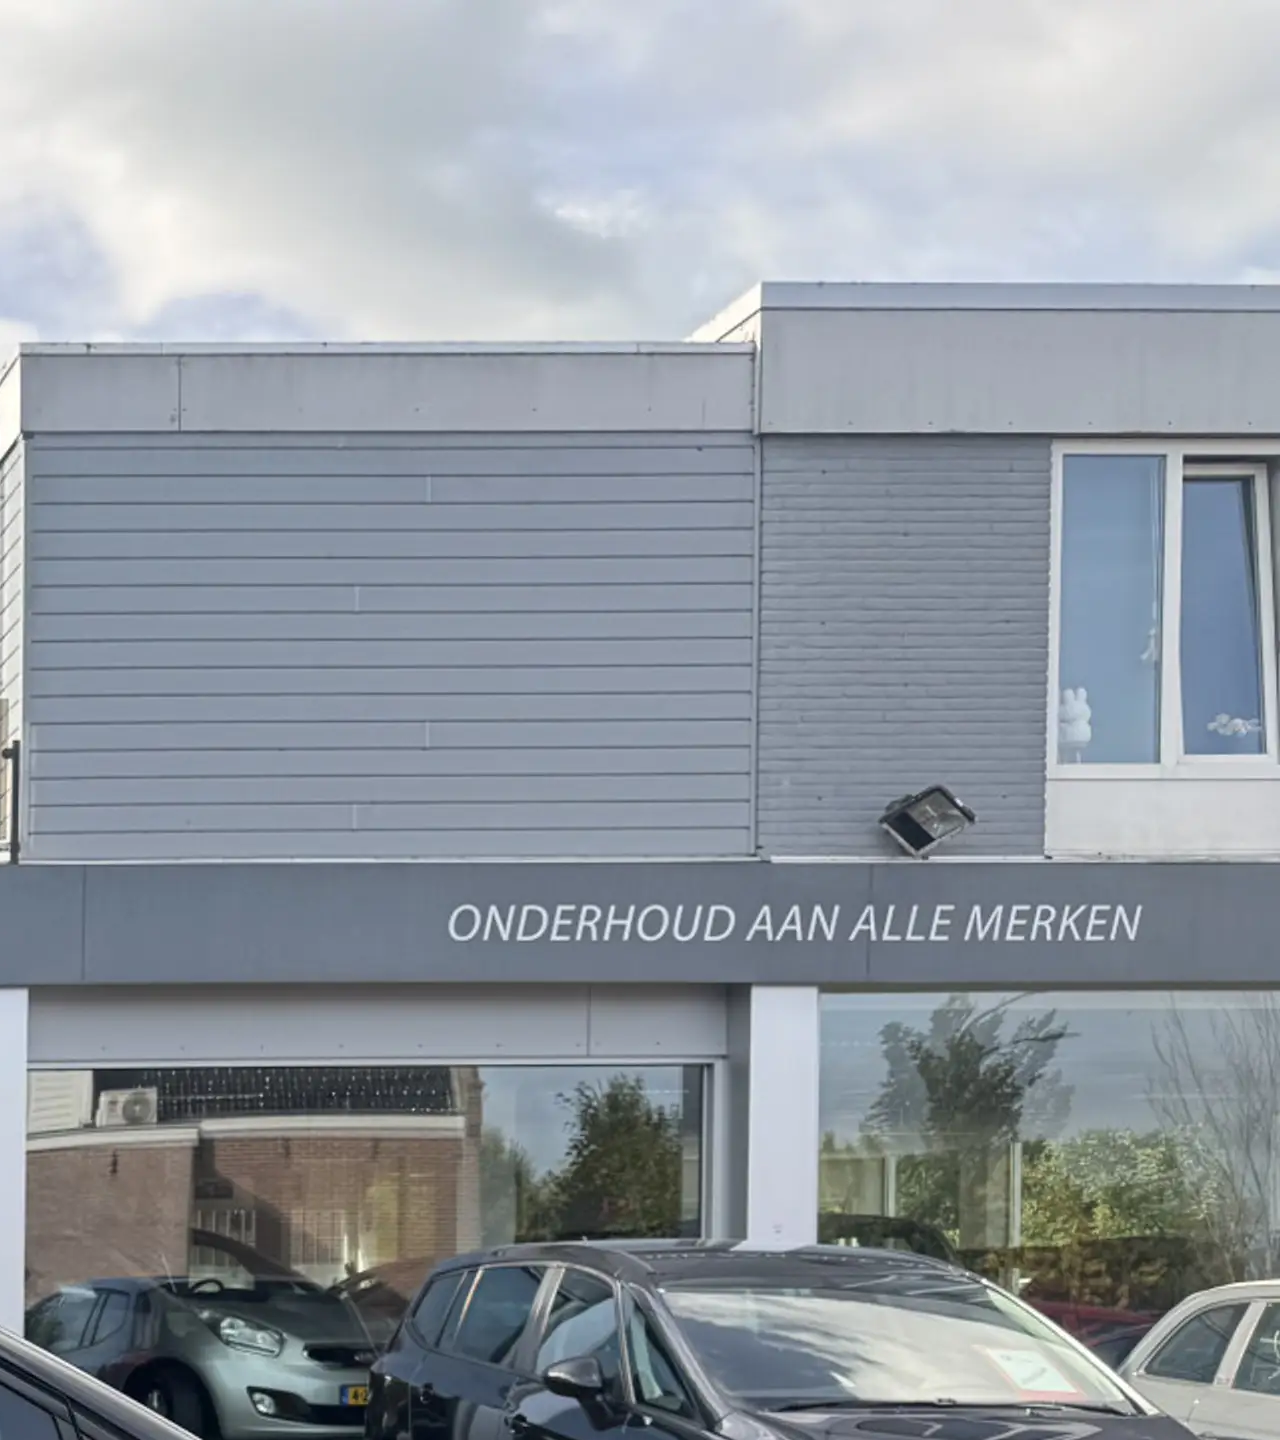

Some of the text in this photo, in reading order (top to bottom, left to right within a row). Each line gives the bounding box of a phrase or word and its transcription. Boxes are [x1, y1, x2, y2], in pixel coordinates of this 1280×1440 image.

[447, 903, 1143, 942] ONDERHOUD AAN ALLE MERKEN
